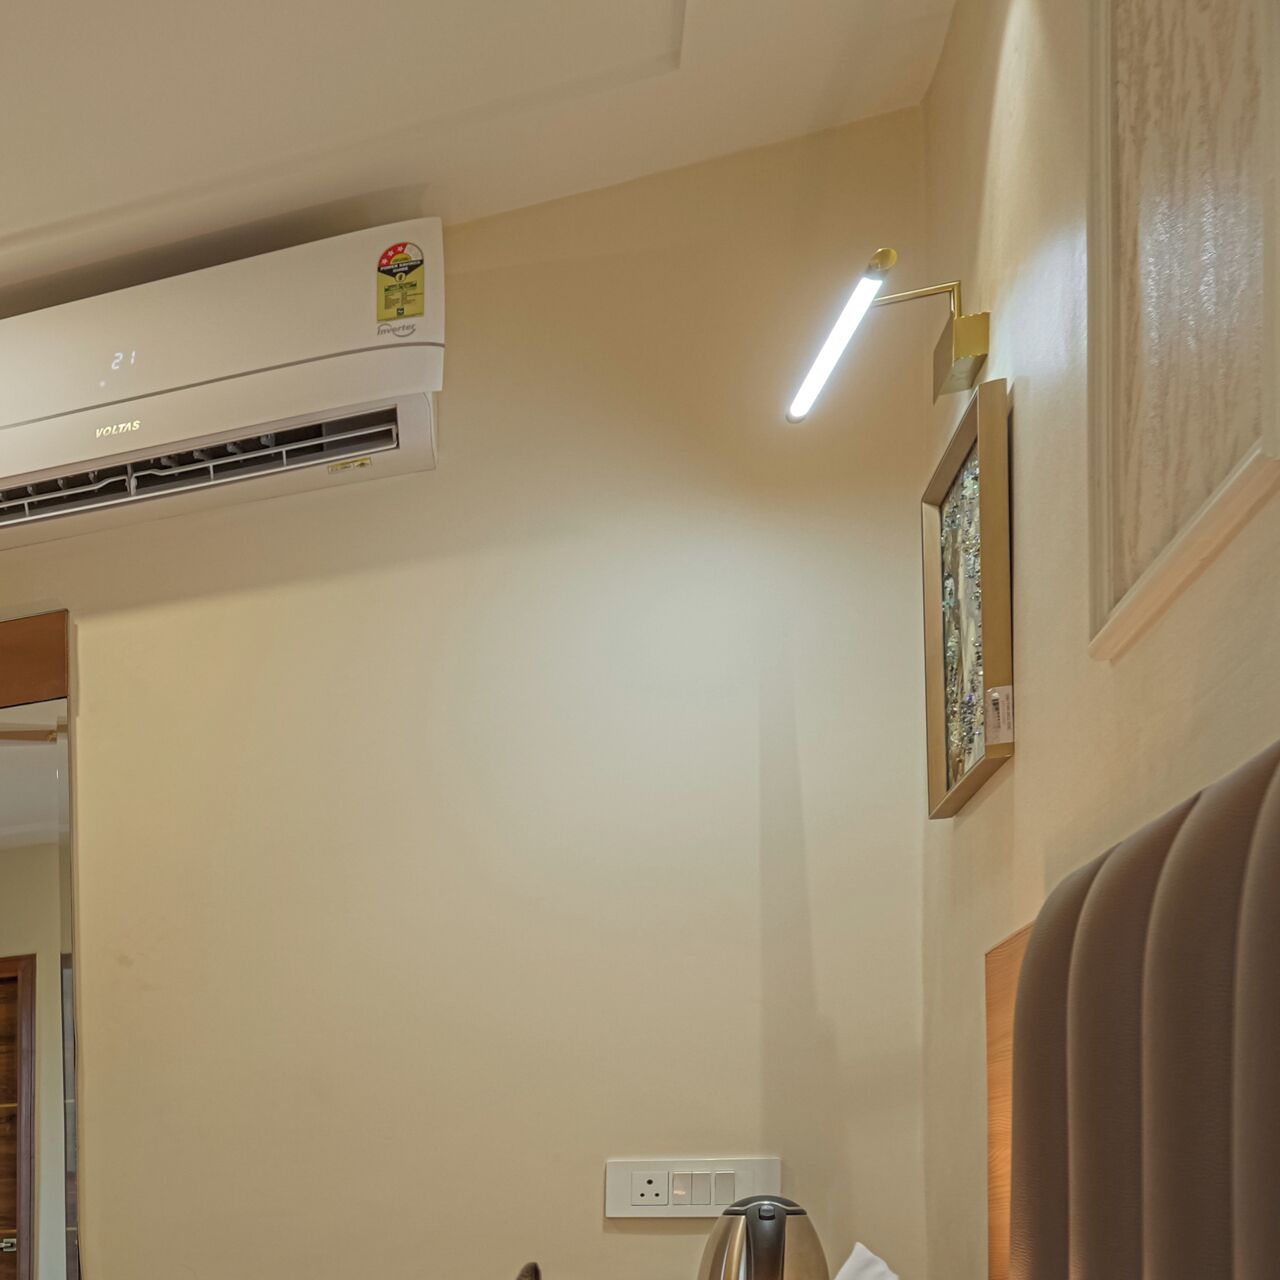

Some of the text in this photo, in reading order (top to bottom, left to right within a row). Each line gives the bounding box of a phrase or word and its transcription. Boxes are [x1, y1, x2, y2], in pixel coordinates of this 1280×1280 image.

[377, 323, 416, 336] Inverter
[111, 350, 136, 370] 21
[95, 420, 141, 439] VOLTAS
